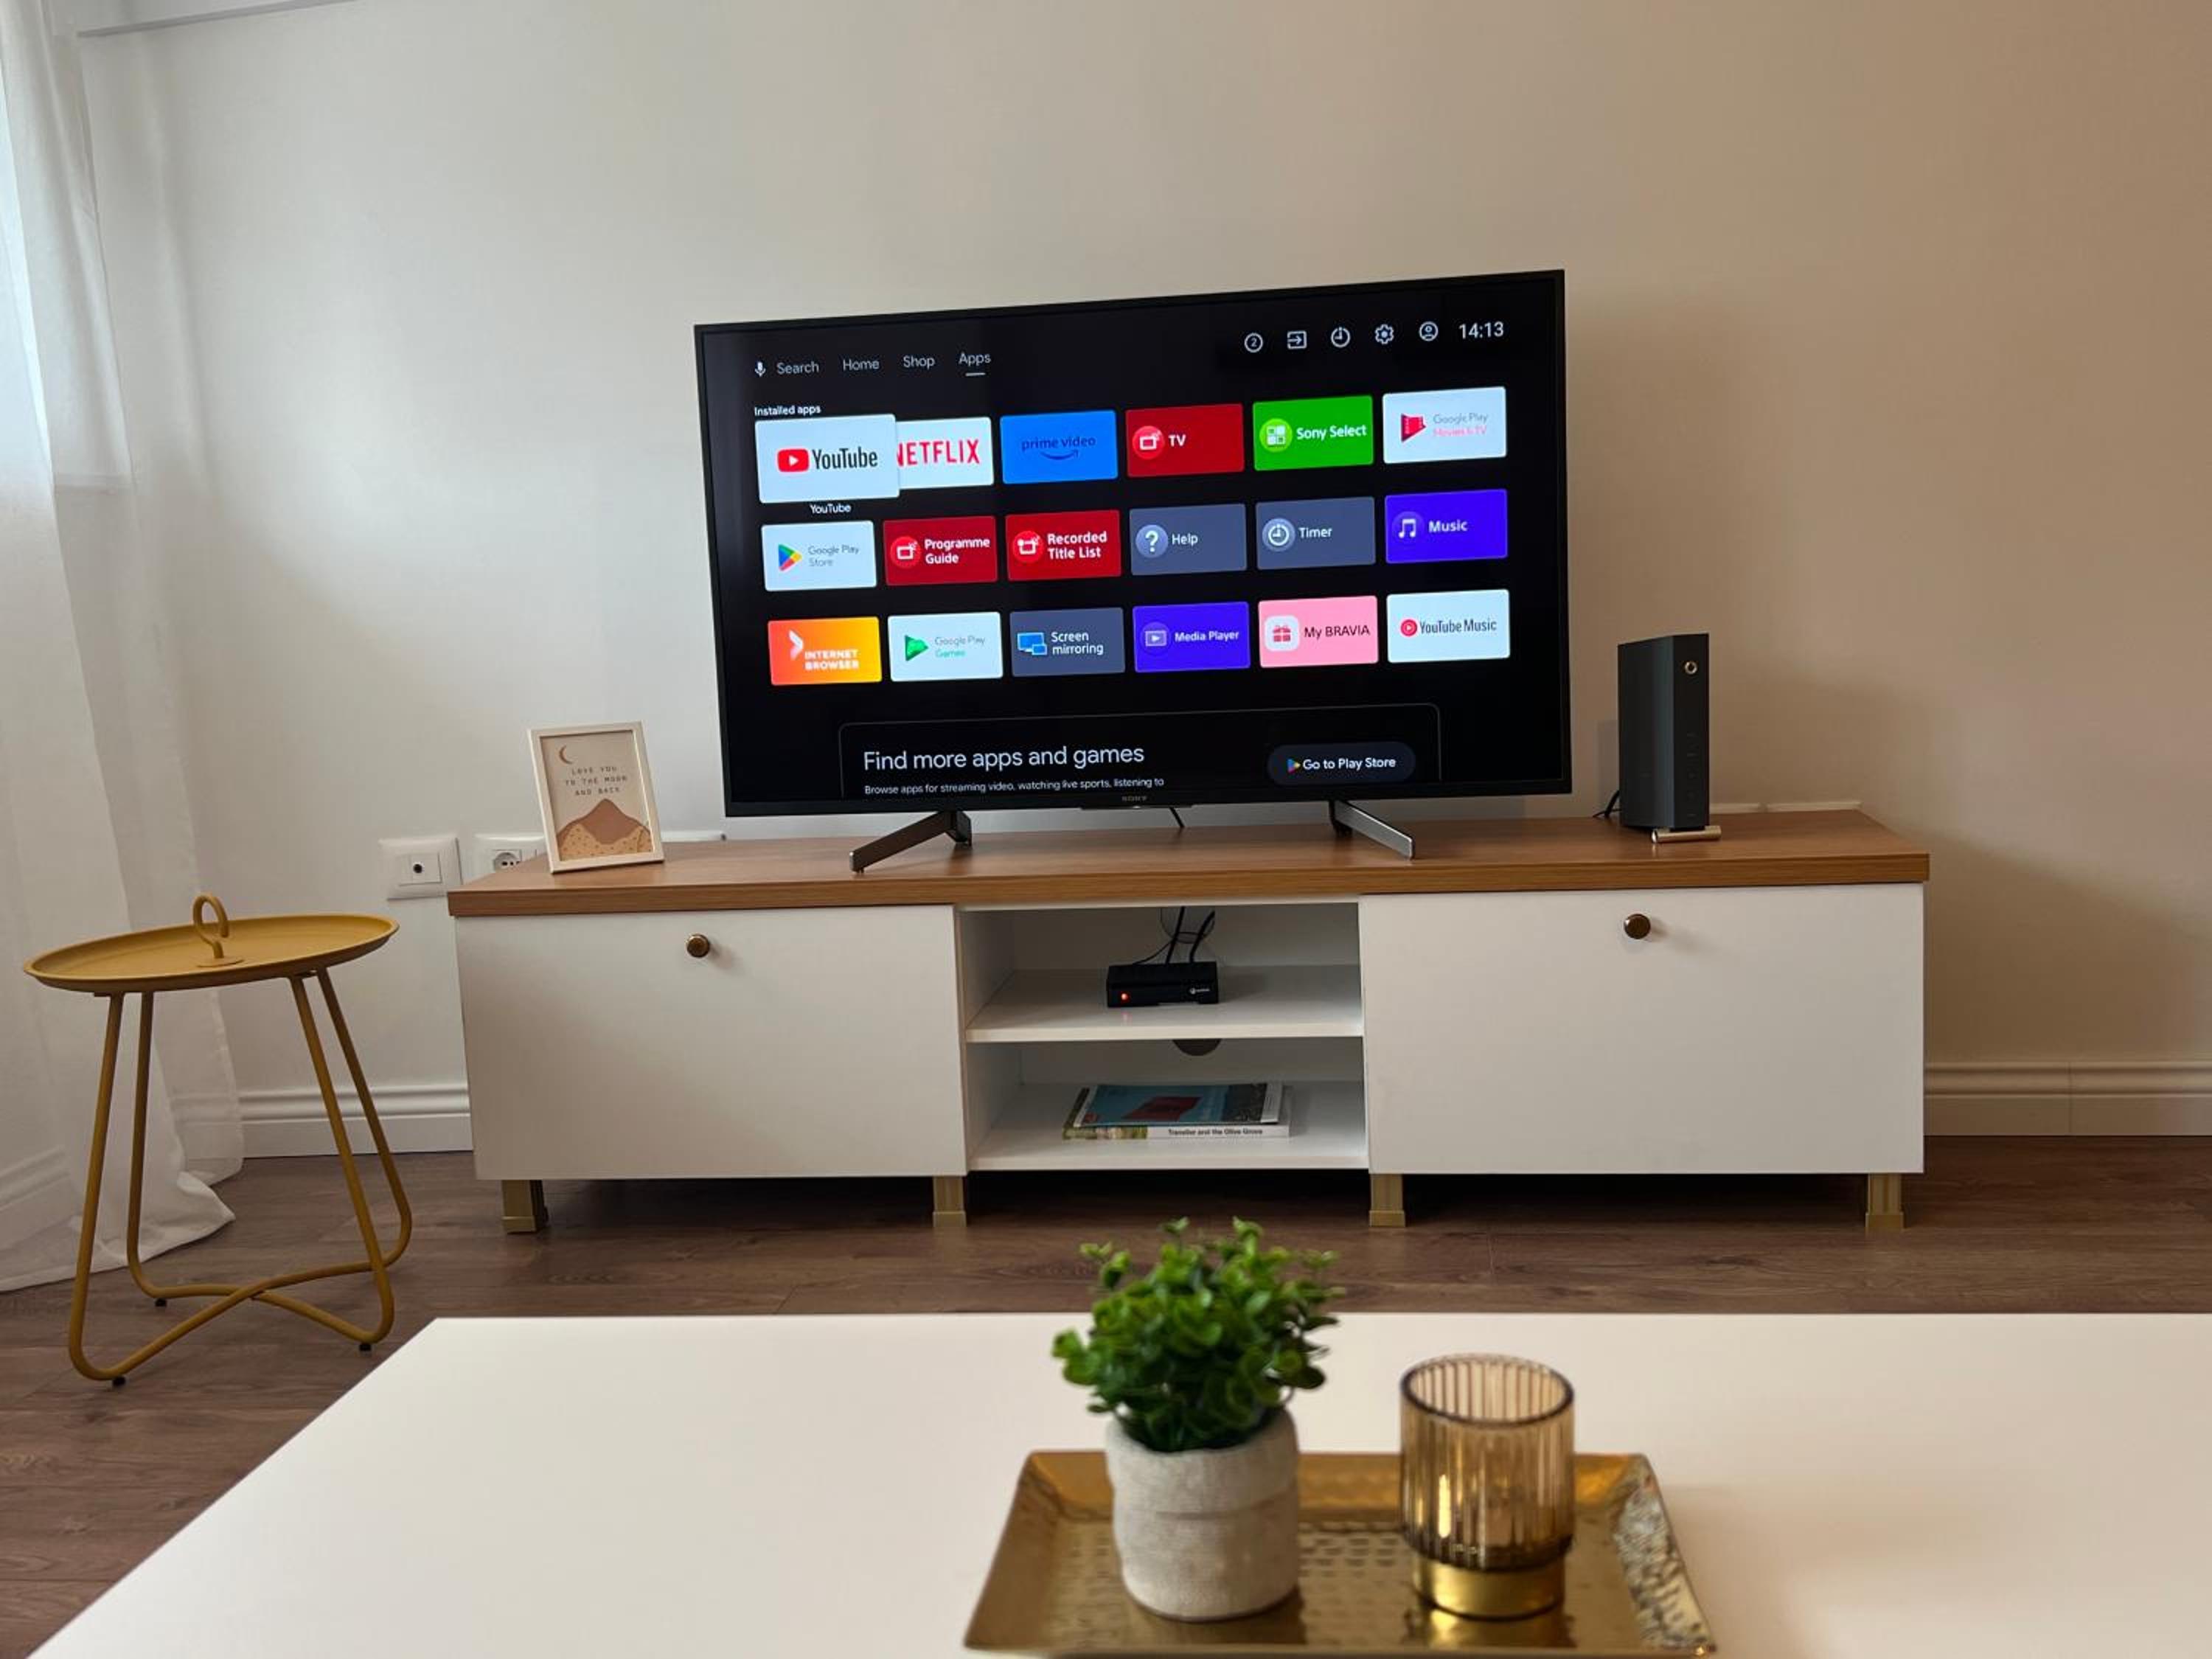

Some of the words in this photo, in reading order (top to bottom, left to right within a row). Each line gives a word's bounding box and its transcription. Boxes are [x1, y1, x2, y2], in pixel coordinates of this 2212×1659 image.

[1458, 322, 1504, 339] 14:13
[842, 358, 880, 372] Home
[902, 355, 936, 369] Shop
[959, 352, 992, 366] Apps
[776, 360, 820, 375] Search
[754, 406, 796, 417] Installed
[797, 405, 821, 417] apps
[1433, 414, 1468, 425] Google
[1468, 412, 1489, 422] Play
[1296, 427, 1327, 442] Sony
[1329, 424, 1367, 438] Select
[1021, 437, 1059, 452] prime
[1061, 436, 1096, 448] video
[1167, 434, 1186, 448] TV
[812, 447, 878, 470] YouTube
[810, 504, 852, 515] YouTube
[1298, 526, 1333, 538] Timer
[1428, 520, 1468, 533] Music
[924, 538, 990, 552] Programme
[1047, 531, 1107, 545] Recorded
[1171, 532, 1198, 547] Help
[807, 545, 840, 557] Google
[841, 544, 860, 555] Play
[1048, 546, 1075, 559] Title
[1079, 546, 1102, 558] List
[808, 557, 833, 567] Store
[925, 552, 959, 565] Guide
[1304, 627, 1322, 641] My
[1324, 624, 1371, 637] BRAVIA
[1419, 619, 1462, 634] YouTube
[1464, 618, 1497, 632] Music
[934, 636, 967, 647] Google
[967, 635, 986, 646] Play
[1051, 631, 1089, 643] Screen
[1174, 631, 1207, 642] Media
[1208, 629, 1240, 644] Player
[804, 648, 859, 660] INTERNET
[1051, 642, 1105, 656] mirroring
[804, 659, 860, 670] BROWSER
[863, 750, 908, 771] Find
[913, 752, 968, 769] more
[972, 751, 1023, 772] apps
[1028, 745, 1068, 766] and
[1073, 747, 1145, 769] games
[1302, 759, 1321, 770] Go
[1323, 759, 1336, 770] to
[1338, 758, 1363, 771] Play
[1365, 757, 1396, 768] Store
[864, 785, 899, 795] Browse
[900, 785, 923, 796] apps
[925, 782, 939, 793] for
[939, 781, 987, 794] streaming
[987, 779, 1016, 791] video,
[1018, 779, 1061, 792] watching
[1062, 779, 1078, 790] live
[1079, 778, 1113, 790] sports,
[1113, 776, 1153, 788] listening
[1154, 776, 1165, 787] to
